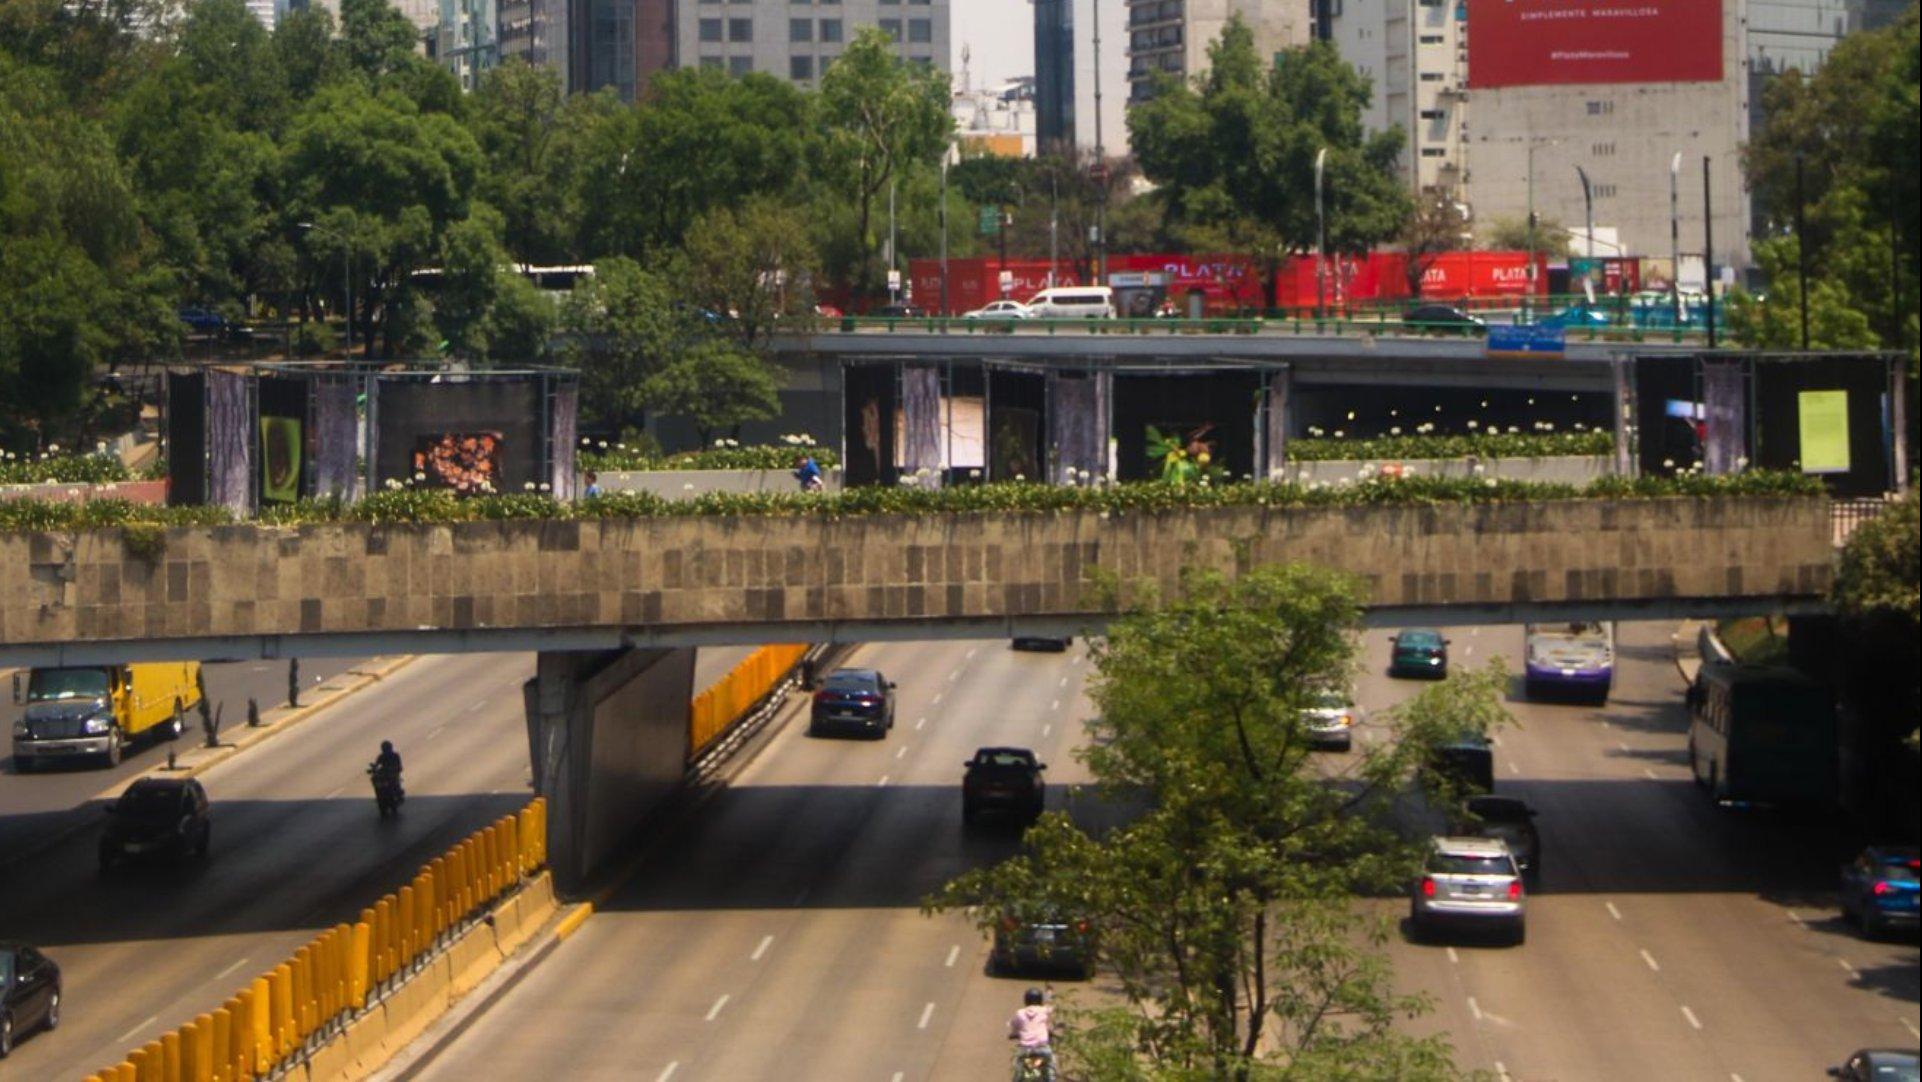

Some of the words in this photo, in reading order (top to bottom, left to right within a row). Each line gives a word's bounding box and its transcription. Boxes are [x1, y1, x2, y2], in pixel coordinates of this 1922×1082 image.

[1520, 9, 1586, 20] SIMPLEMENTE
[1592, 7, 1659, 17] MARAVILLOSA
[1421, 268, 1447, 282] ATA
[1491, 267, 1527, 281] PLATA
